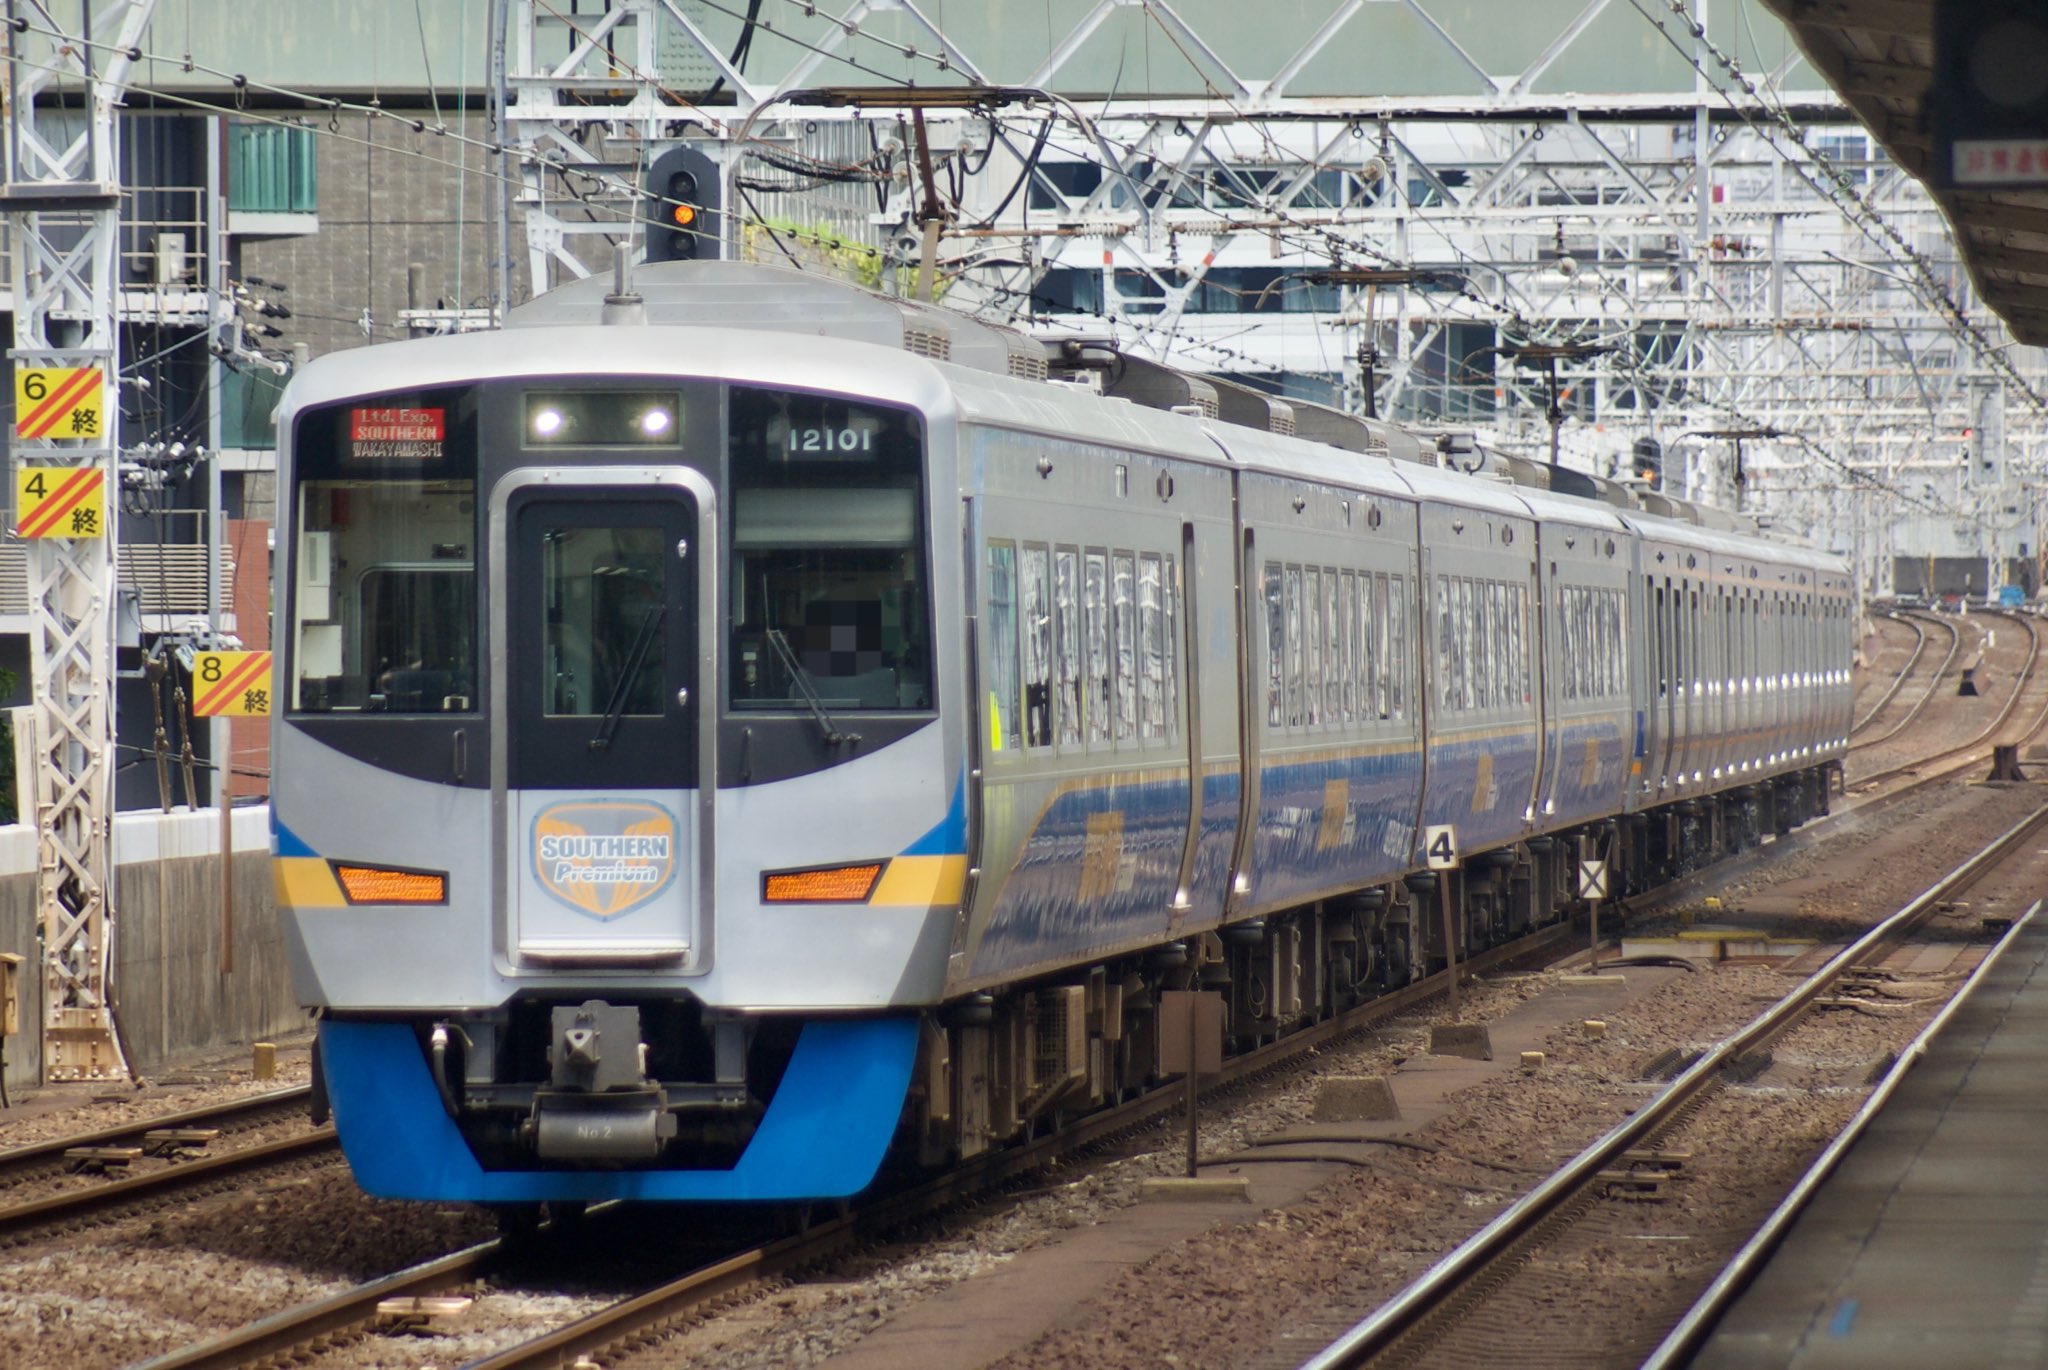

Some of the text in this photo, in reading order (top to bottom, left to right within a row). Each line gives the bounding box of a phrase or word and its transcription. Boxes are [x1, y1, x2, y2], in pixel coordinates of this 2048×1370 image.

[24, 373, 47, 400] 6
[71, 408, 98, 434] 終
[361, 409, 434, 425] Ltd. Exp.
[357, 426, 437, 440] SOUTHERN
[790, 429, 870, 451] 12101
[353, 442, 443, 457] WAKAYAMASHI
[25, 473, 47, 499] 4
[71, 508, 98, 533] 終
[202, 656, 222, 682] 8
[245, 689, 269, 713] 終
[540, 835, 669, 859] SOUTHERN
[1429, 831, 1454, 863] 4
[553, 860, 658, 882] Premium
